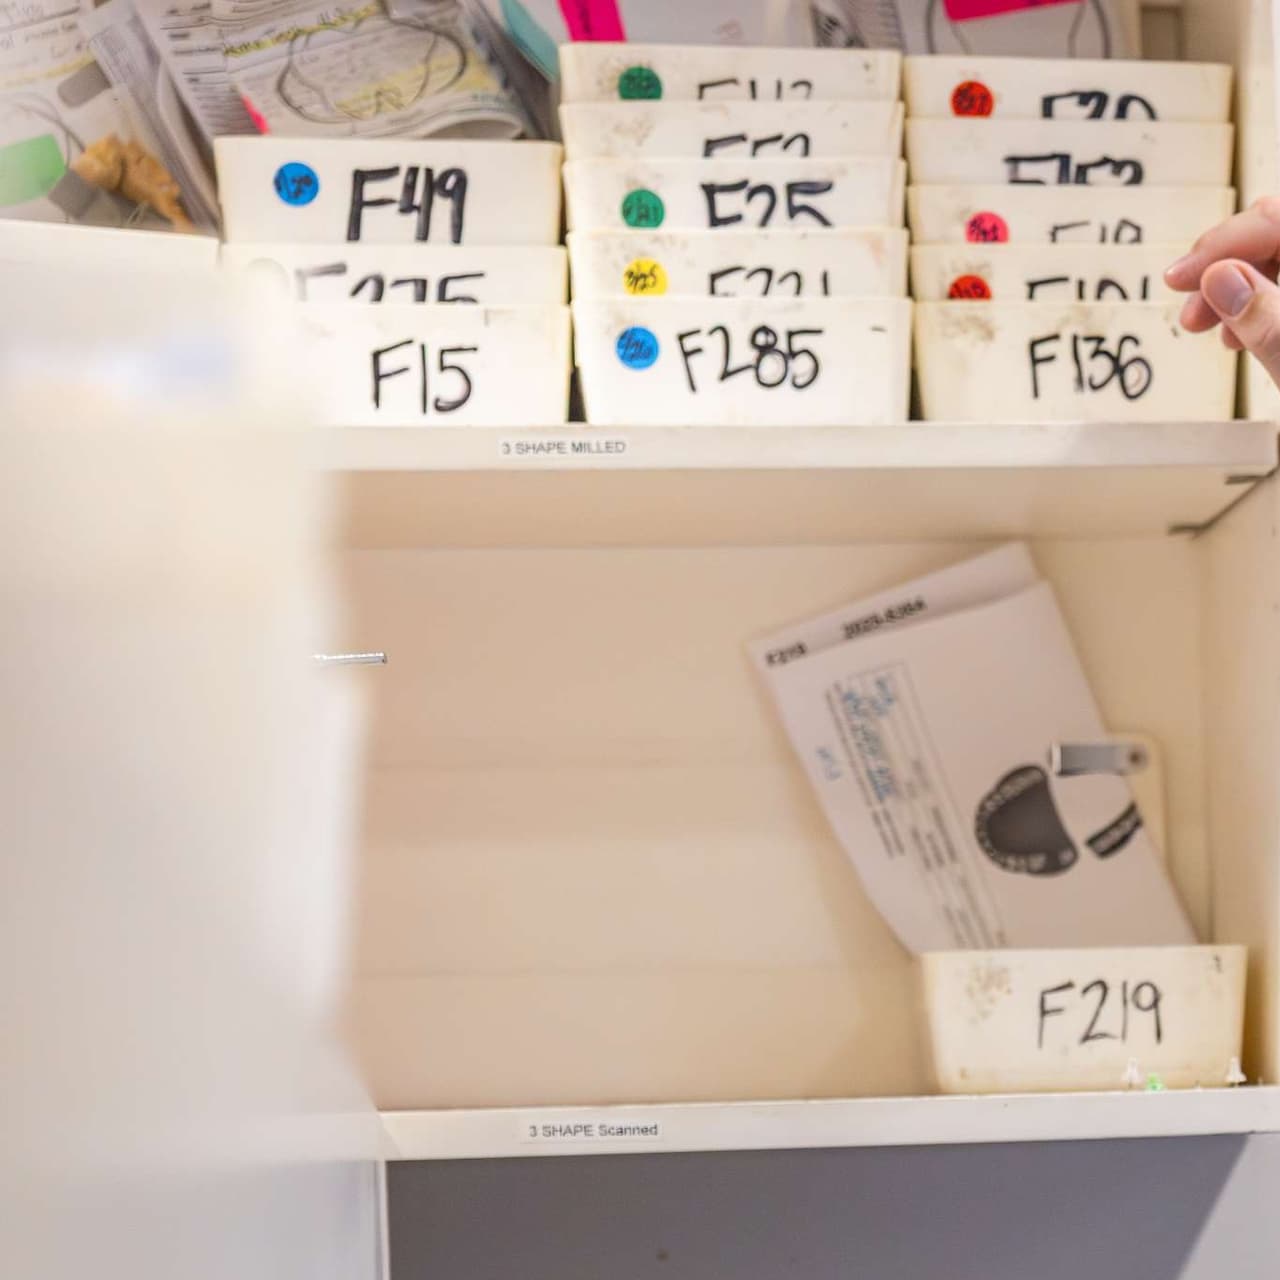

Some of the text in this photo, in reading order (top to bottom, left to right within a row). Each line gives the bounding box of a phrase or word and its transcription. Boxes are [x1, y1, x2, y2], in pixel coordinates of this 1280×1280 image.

[345, 165, 468, 244] F49
[371, 340, 478, 414] F15
[676, 325, 824, 393] F285
[1028, 334, 1151, 400] F136
[515, 441, 568, 455] SHAPE
[571, 440, 626, 454] MILLED
[1037, 979, 1162, 1050] F219
[529, 1124, 658, 1137] 3 SHAPE Scanned
